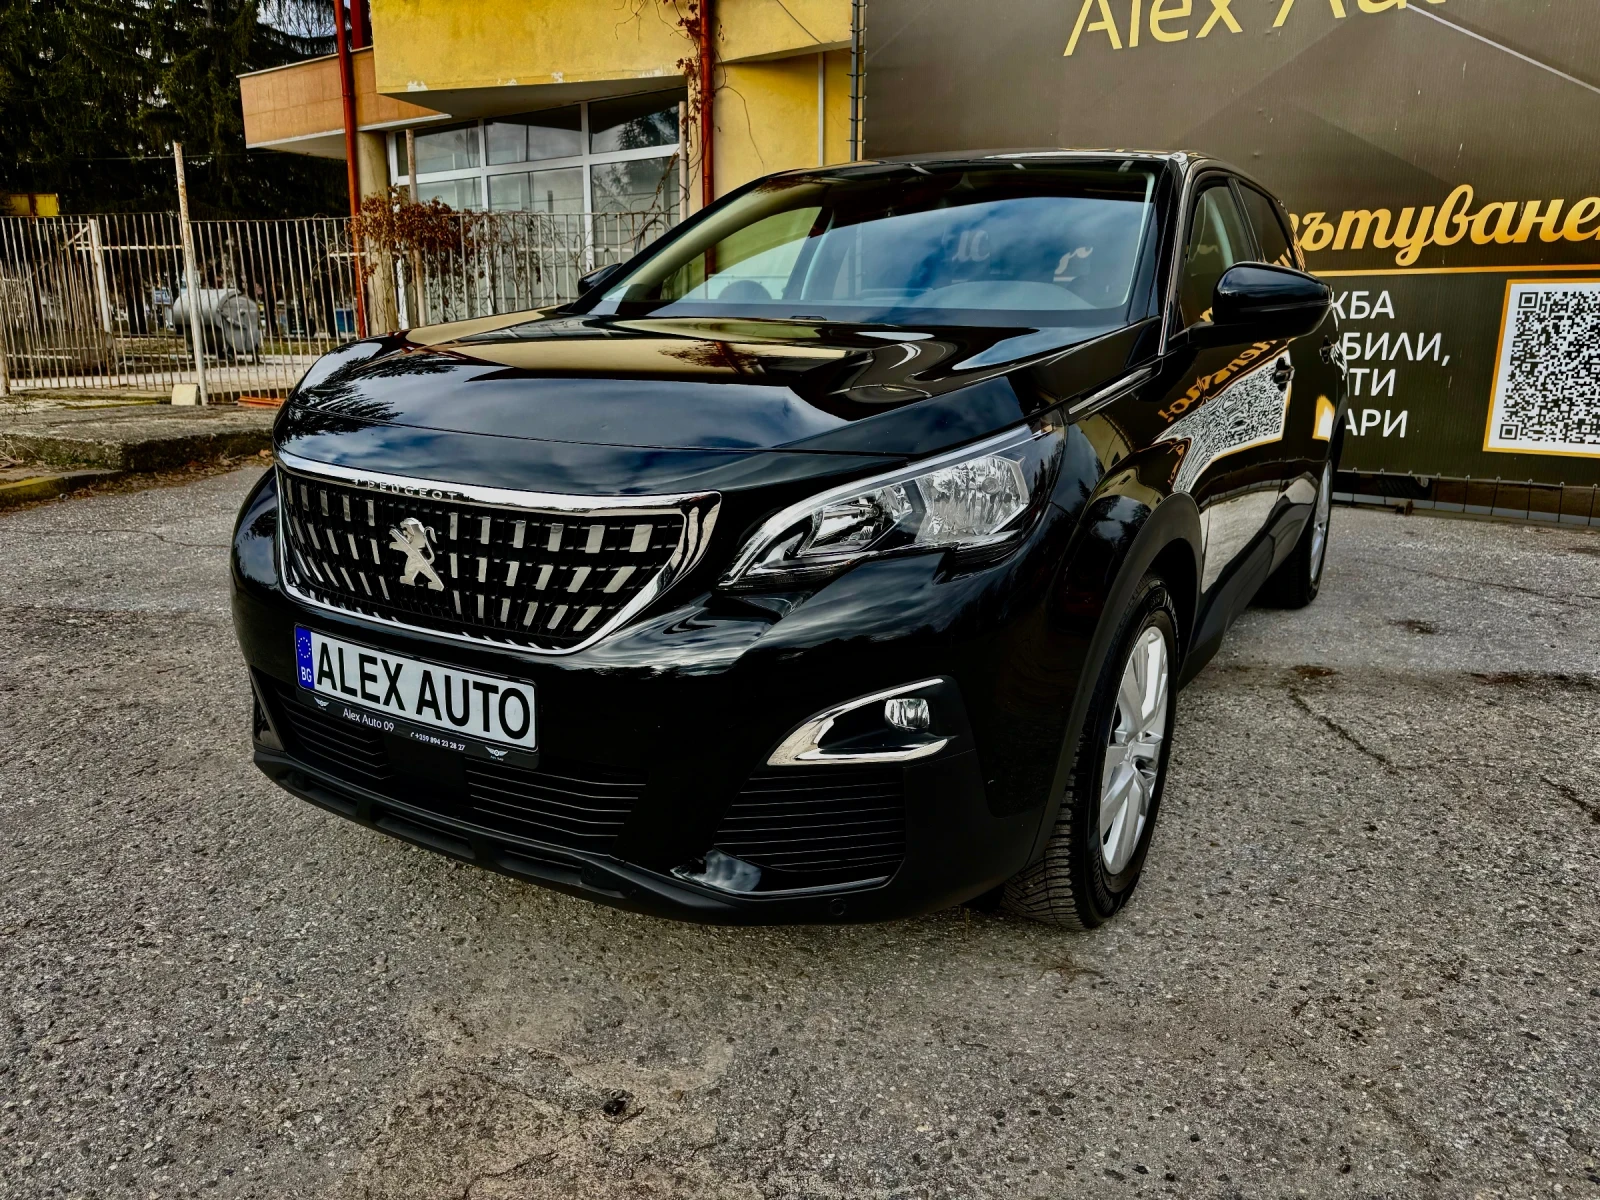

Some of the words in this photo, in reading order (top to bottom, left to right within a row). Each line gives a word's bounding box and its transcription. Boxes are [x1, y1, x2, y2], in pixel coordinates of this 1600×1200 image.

[1063, 0, 1243, 56] Alex
[1289, 184, 1600, 266] ътуване
[1342, 332, 1450, 366] БИЛИ,
[1349, 368, 1396, 397] ТИ
[1345, 408, 1408, 438] АРИ
[367, 480, 457, 500] PEUGEOT
[301, 666, 312, 683] BG
[316, 641, 406, 711] ALEX
[415, 669, 531, 740] AUTO
[343, 707, 361, 723] Alex
[361, 714, 382, 729] Auto
[383, 721, 395, 731] 09
